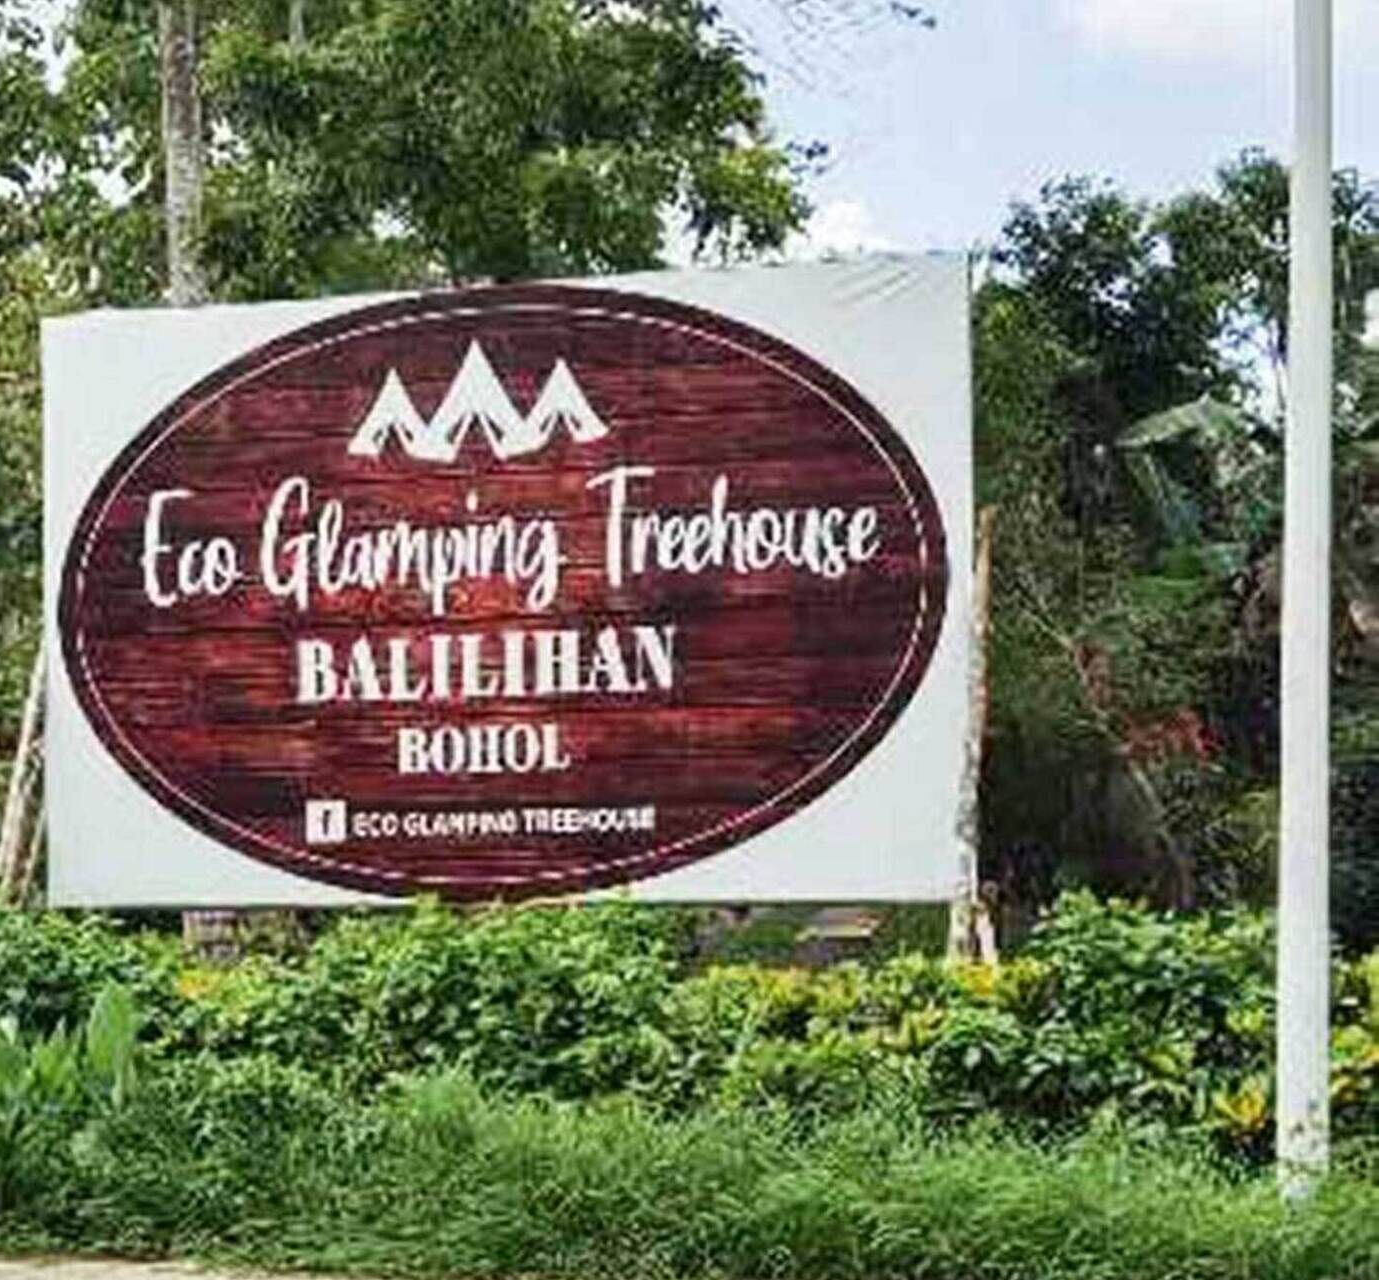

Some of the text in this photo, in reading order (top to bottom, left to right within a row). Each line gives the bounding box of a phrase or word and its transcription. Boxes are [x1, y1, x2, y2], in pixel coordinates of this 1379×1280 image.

[143, 465, 882, 616] Eco Glamping Treehouse
[296, 624, 676, 705] BALILIHAN
[397, 722, 571, 776] BOHOL
[351, 812, 399, 838] ECO
